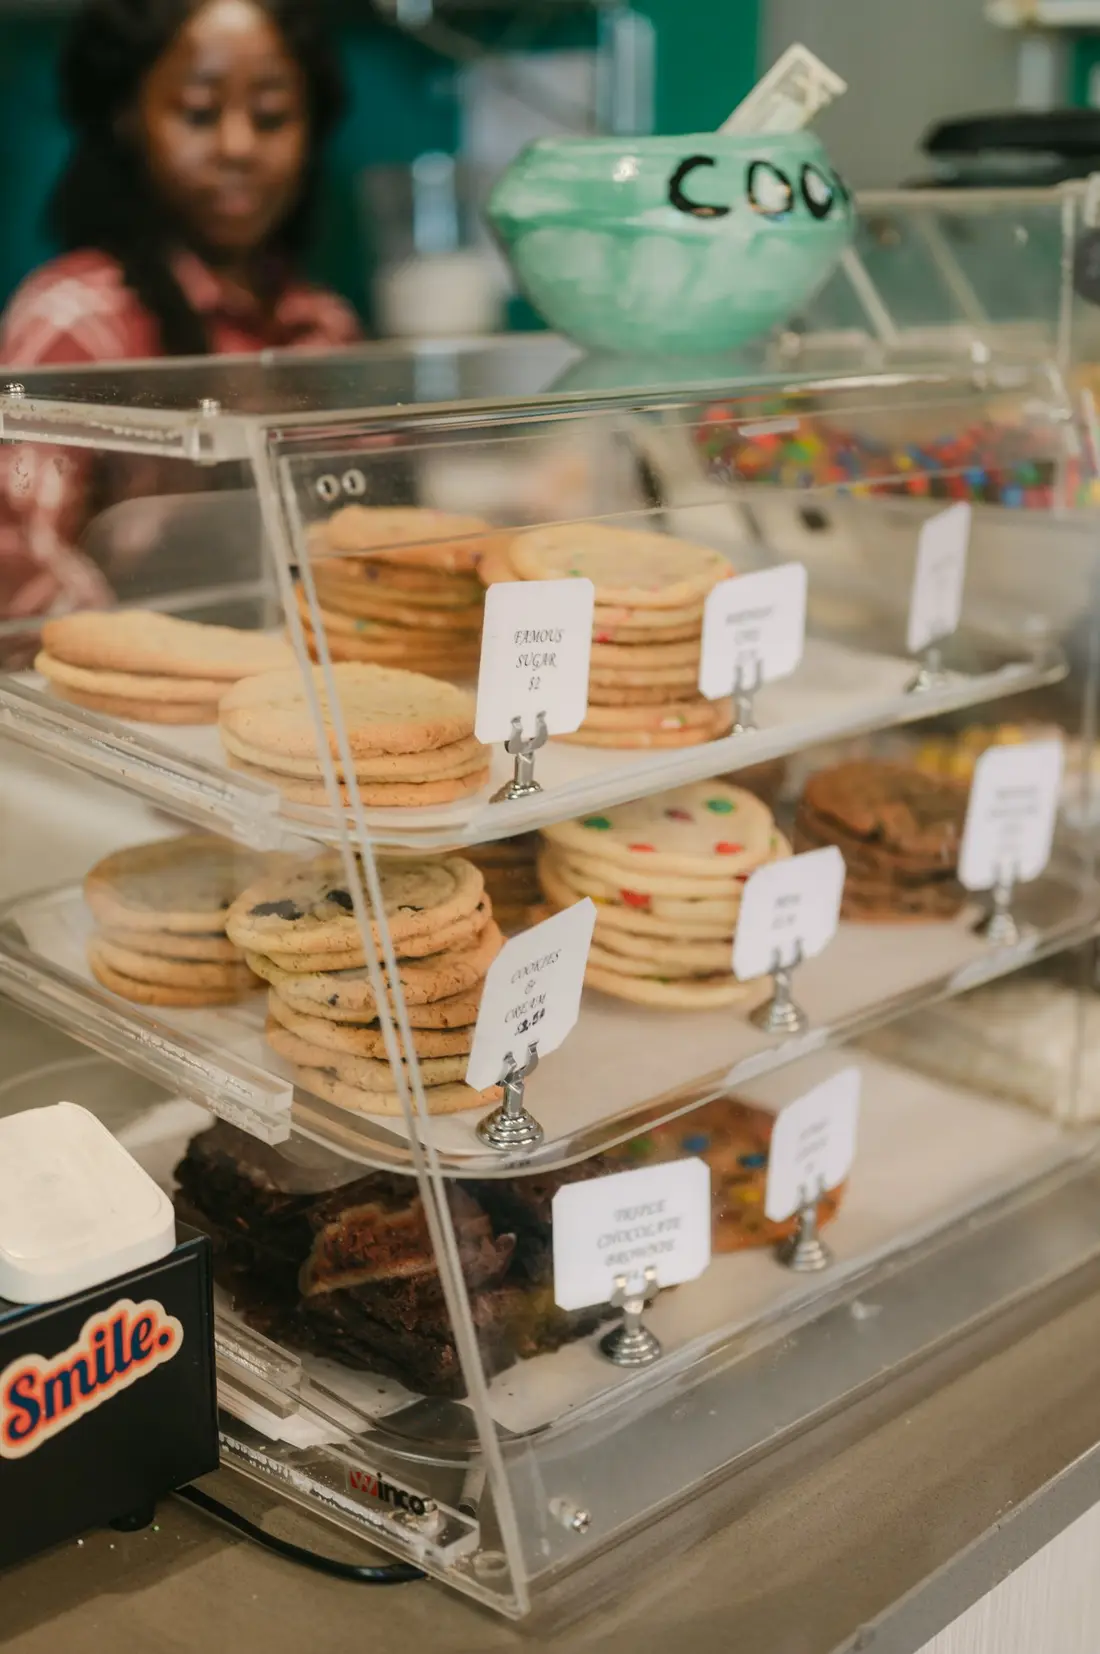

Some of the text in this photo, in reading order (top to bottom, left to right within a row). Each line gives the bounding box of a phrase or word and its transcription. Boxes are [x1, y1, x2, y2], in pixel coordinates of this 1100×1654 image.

[513, 627, 563, 646] FAMOUS
[515, 651, 557, 671] SUGAR
[528, 676, 541, 692] $2
[510, 949, 562, 984] COOKIES
[504, 992, 547, 1024] CREAM
[597, 1215, 682, 1249] CHOCOLATE
